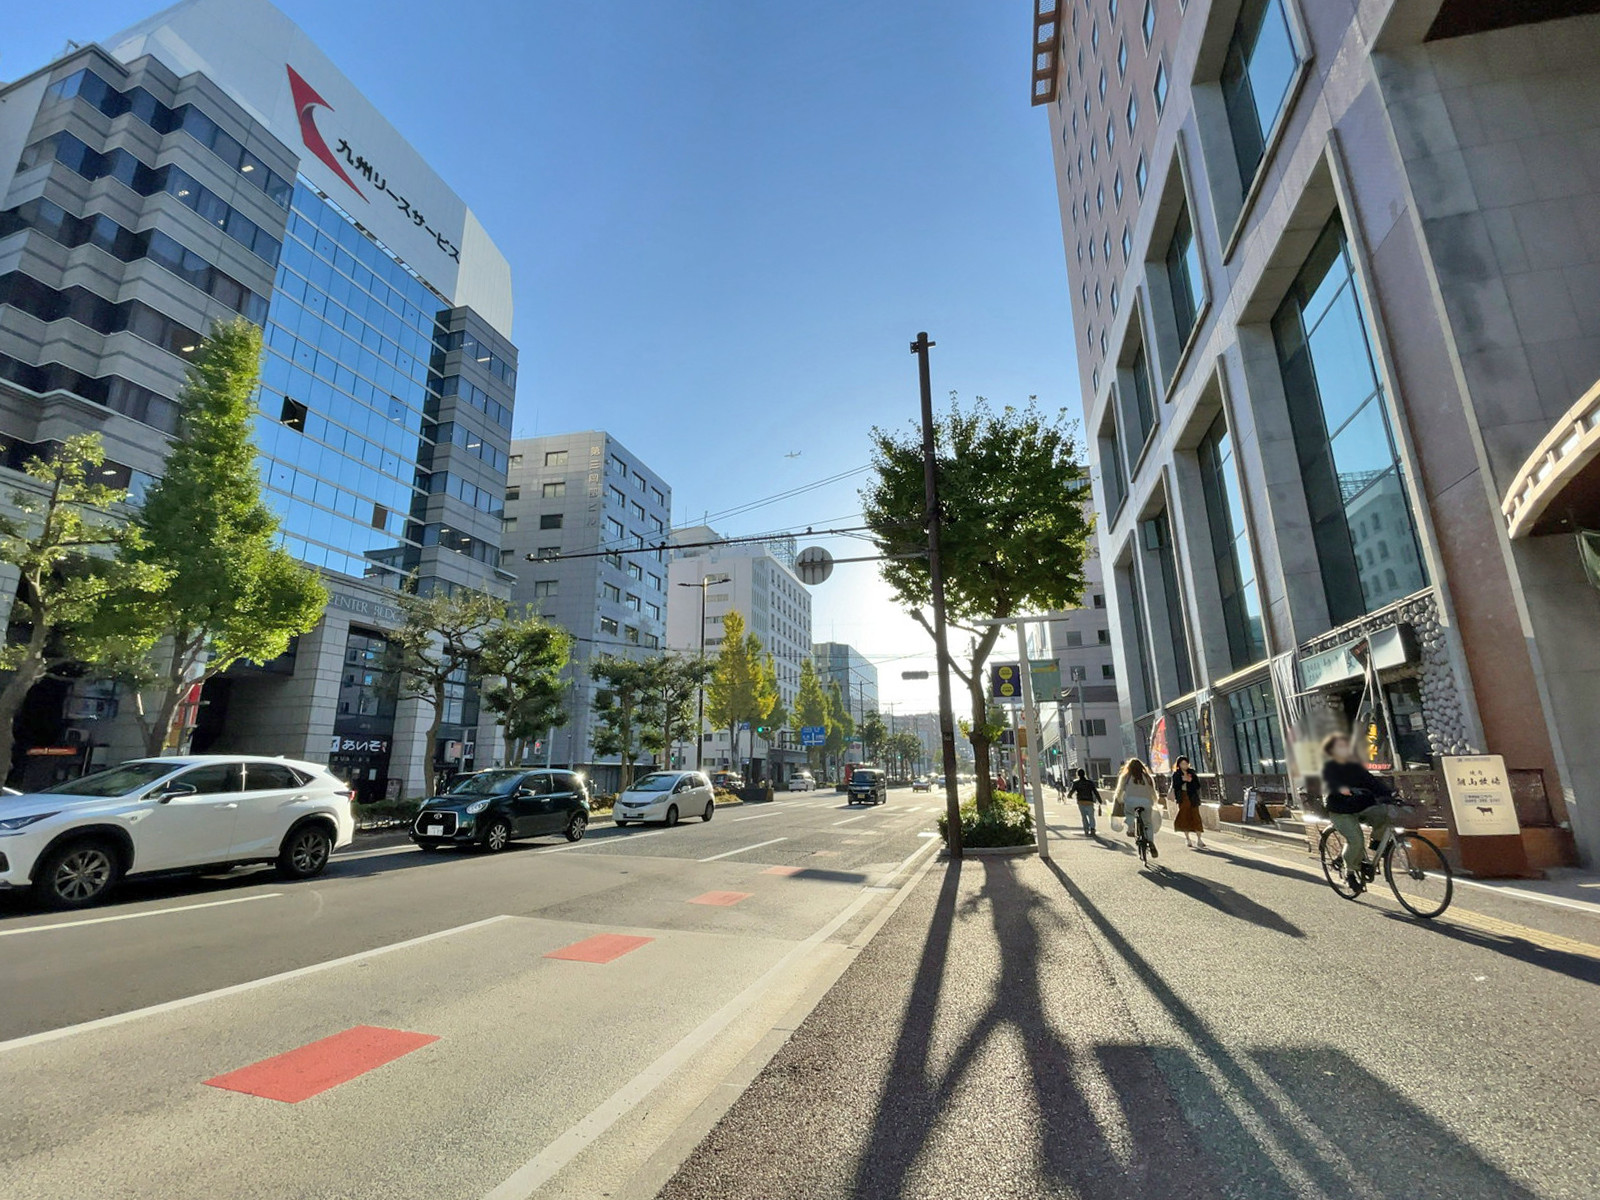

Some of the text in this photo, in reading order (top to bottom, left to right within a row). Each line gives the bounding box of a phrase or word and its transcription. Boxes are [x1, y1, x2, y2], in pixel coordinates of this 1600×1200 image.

[336, 138, 460, 264] 九州リースサービス
[329, 593, 368, 614] ENTER
